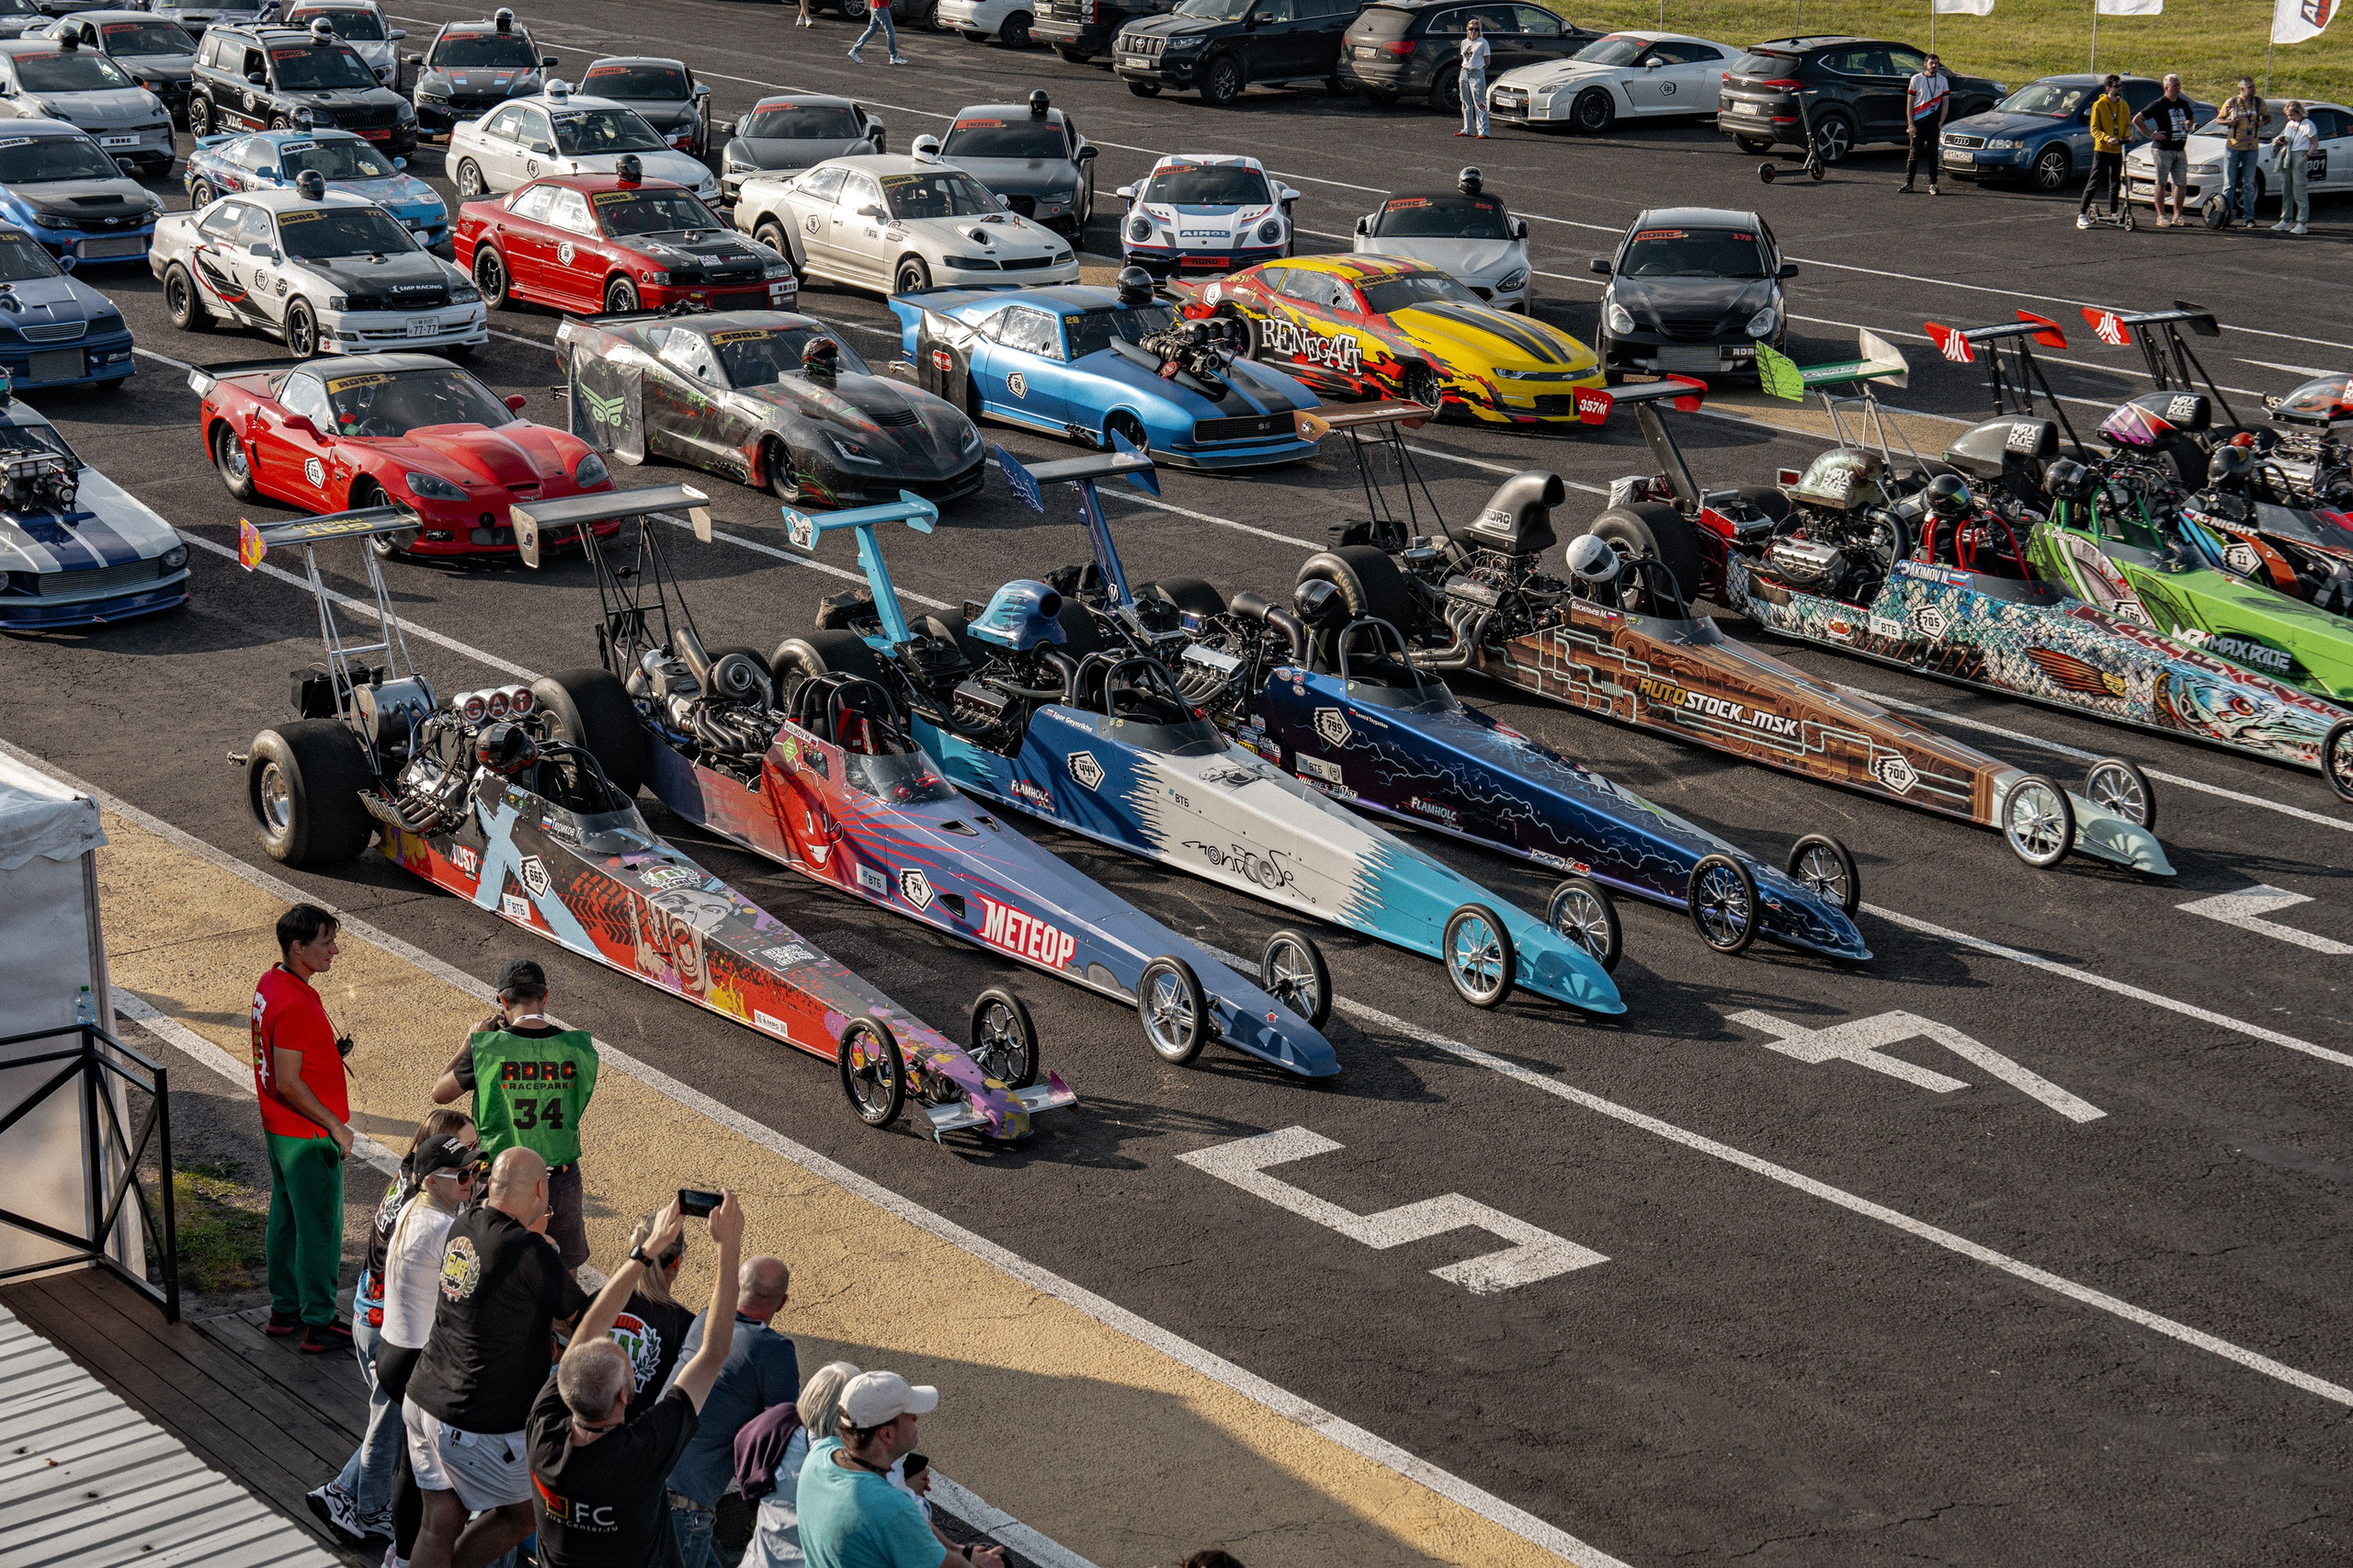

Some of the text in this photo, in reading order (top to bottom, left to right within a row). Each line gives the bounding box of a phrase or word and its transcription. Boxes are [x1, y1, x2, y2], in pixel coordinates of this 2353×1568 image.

[225, 113, 243, 129] VAG
[283, 143, 313, 153] RDRC
[2307, 158, 2325, 171] 301
[882, 176, 912, 185] RDRC
[595, 194, 628, 203] RDRC
[280, 213, 314, 223] RDRC
[1638, 231, 1676, 239] RDRC
[778, 283, 796, 291] RDRC
[1358, 275, 1392, 286] RDRC
[1065, 316, 1079, 324] 28
[414, 324, 437, 335] 77-77
[721, 332, 762, 341] RDRC
[337, 375, 381, 389] RDRC
[1579, 398, 1608, 415] 357M
[2171, 395, 2200, 406] MAX
[2168, 404, 2195, 415] RIDE
[2011, 422, 2042, 437] MAX
[2006, 432, 2036, 448] RIDE
[1825, 466, 1854, 483] MAX
[1820, 478, 1850, 493] RIDE
[1485, 509, 1510, 523] RDRC
[305, 522, 373, 537] GAT
[2211, 517, 2258, 536] NIGHT
[2237, 554, 2247, 565] 11
[1910, 563, 1941, 583] AKIMOV
[1571, 601, 1599, 617] Васильев
[1881, 622, 1897, 635] ВТБ
[1923, 616, 1939, 627] 705
[2248, 644, 2292, 671] RIDE
[464, 693, 527, 719] GAT
[1638, 676, 1799, 737] AUTOSTOCK_MSK
[1052, 711, 1093, 733] Igor Geynrikhs
[1326, 719, 1342, 733] 799
[785, 722, 804, 740] KULIKOV
[1263, 740, 1280, 755] WELD
[1080, 764, 1096, 778] 444
[1309, 762, 1323, 774] ВТБ
[1887, 766, 1906, 780] 700
[1298, 774, 1329, 790] HUGHES
[1175, 793, 1189, 807] ВТБ
[1411, 796, 1457, 821] FLAMHOLC
[551, 818, 574, 836] Тюриков
[449, 844, 478, 872] JUST
[529, 869, 543, 883] 666
[869, 876, 881, 888] ВТБ
[662, 877, 700, 890] FAMILY
[912, 884, 922, 896] 74
[512, 904, 525, 915] ВТБ
[500, 1061, 577, 1080] RDRC
[1724, 1009, 2108, 1123] 4
[509, 1082, 569, 1090] RACEPARK
[513, 1097, 563, 1130] 34
[1174, 1125, 1611, 1296] 5
[445, 1253, 469, 1283] GAT
[574, 1502, 615, 1526] FC
